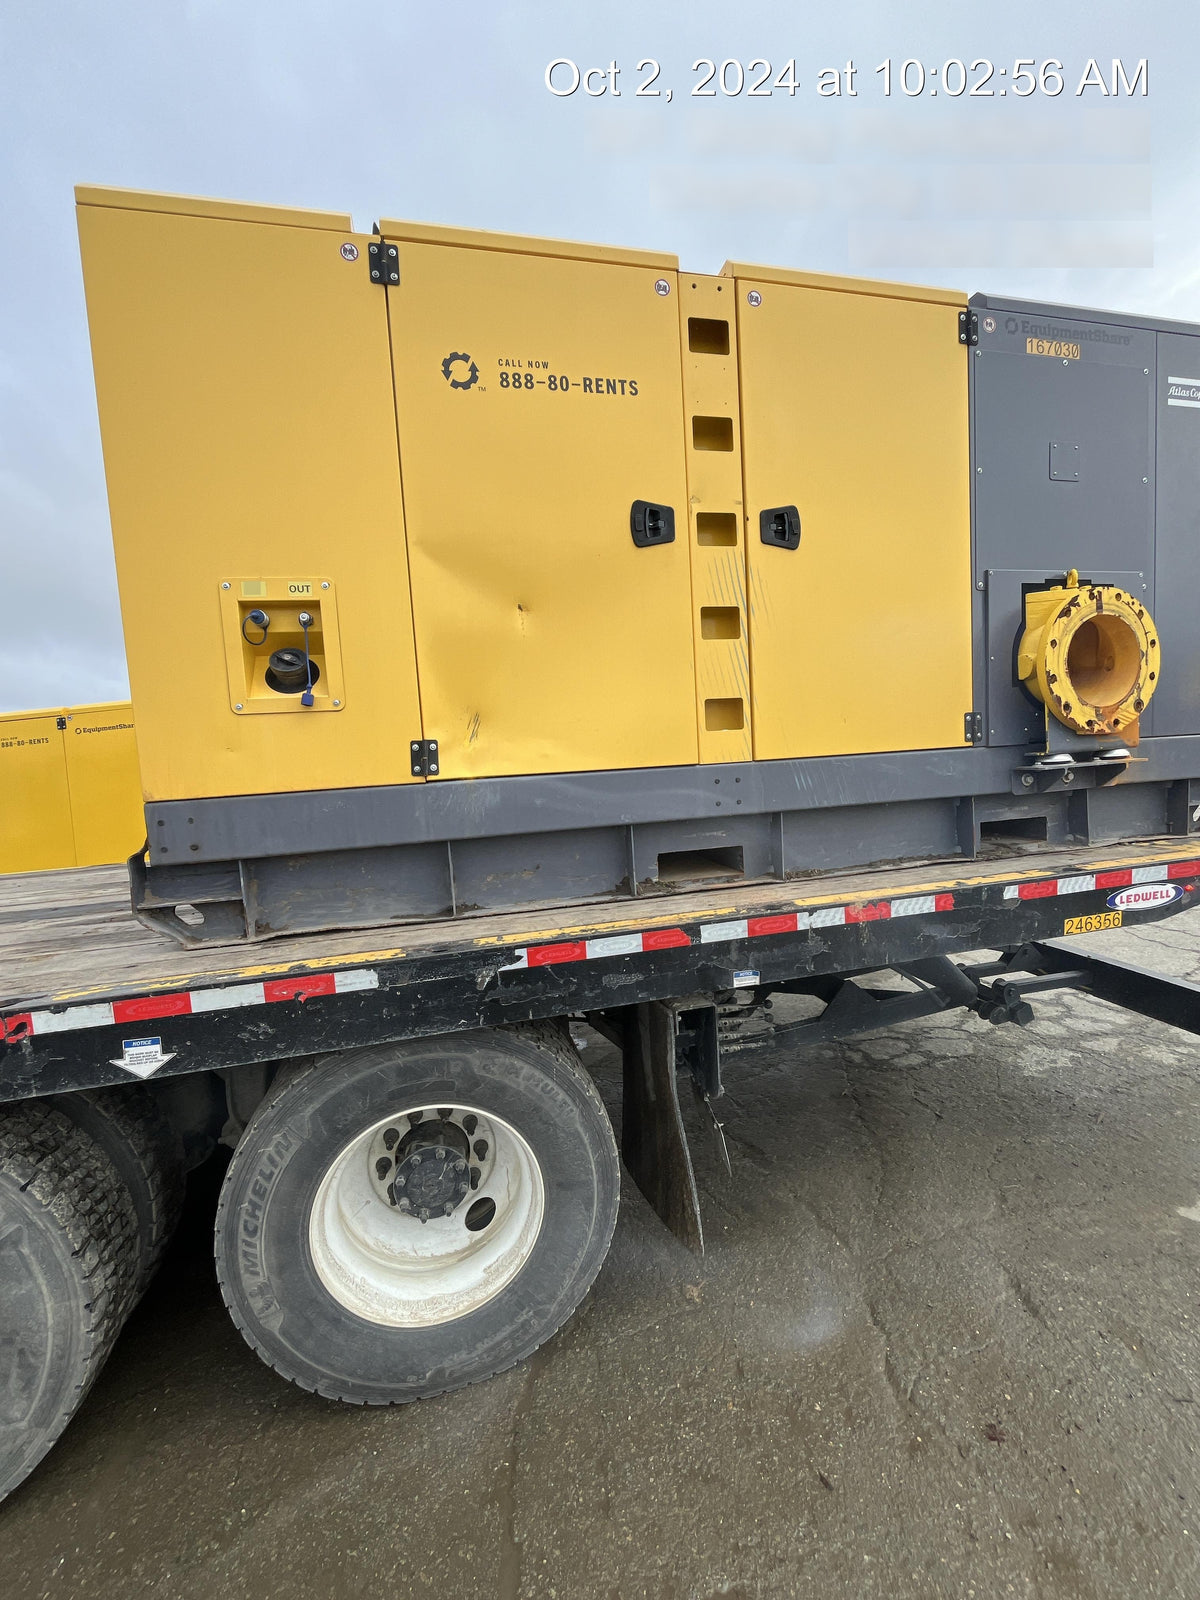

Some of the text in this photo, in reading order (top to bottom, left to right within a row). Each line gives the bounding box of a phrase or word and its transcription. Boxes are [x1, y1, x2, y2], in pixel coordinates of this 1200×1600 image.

[1021, 320, 1131, 346] EquipmentShare
[1027, 338, 1080, 359] 167030
[498, 358, 549, 370] CALL NOW
[499, 371, 639, 396] 888-80-RENTS
[1168, 386, 1190, 397] Atlas
[289, 584, 311, 593] OUT
[82, 723, 135, 733] EquipmentShar
[1119, 889, 1171, 905] LEDWELL
[1065, 912, 1121, 934] 246356
[132, 1039, 152, 1047] NOTICE
[241, 1131, 293, 1277] MICHELIN
